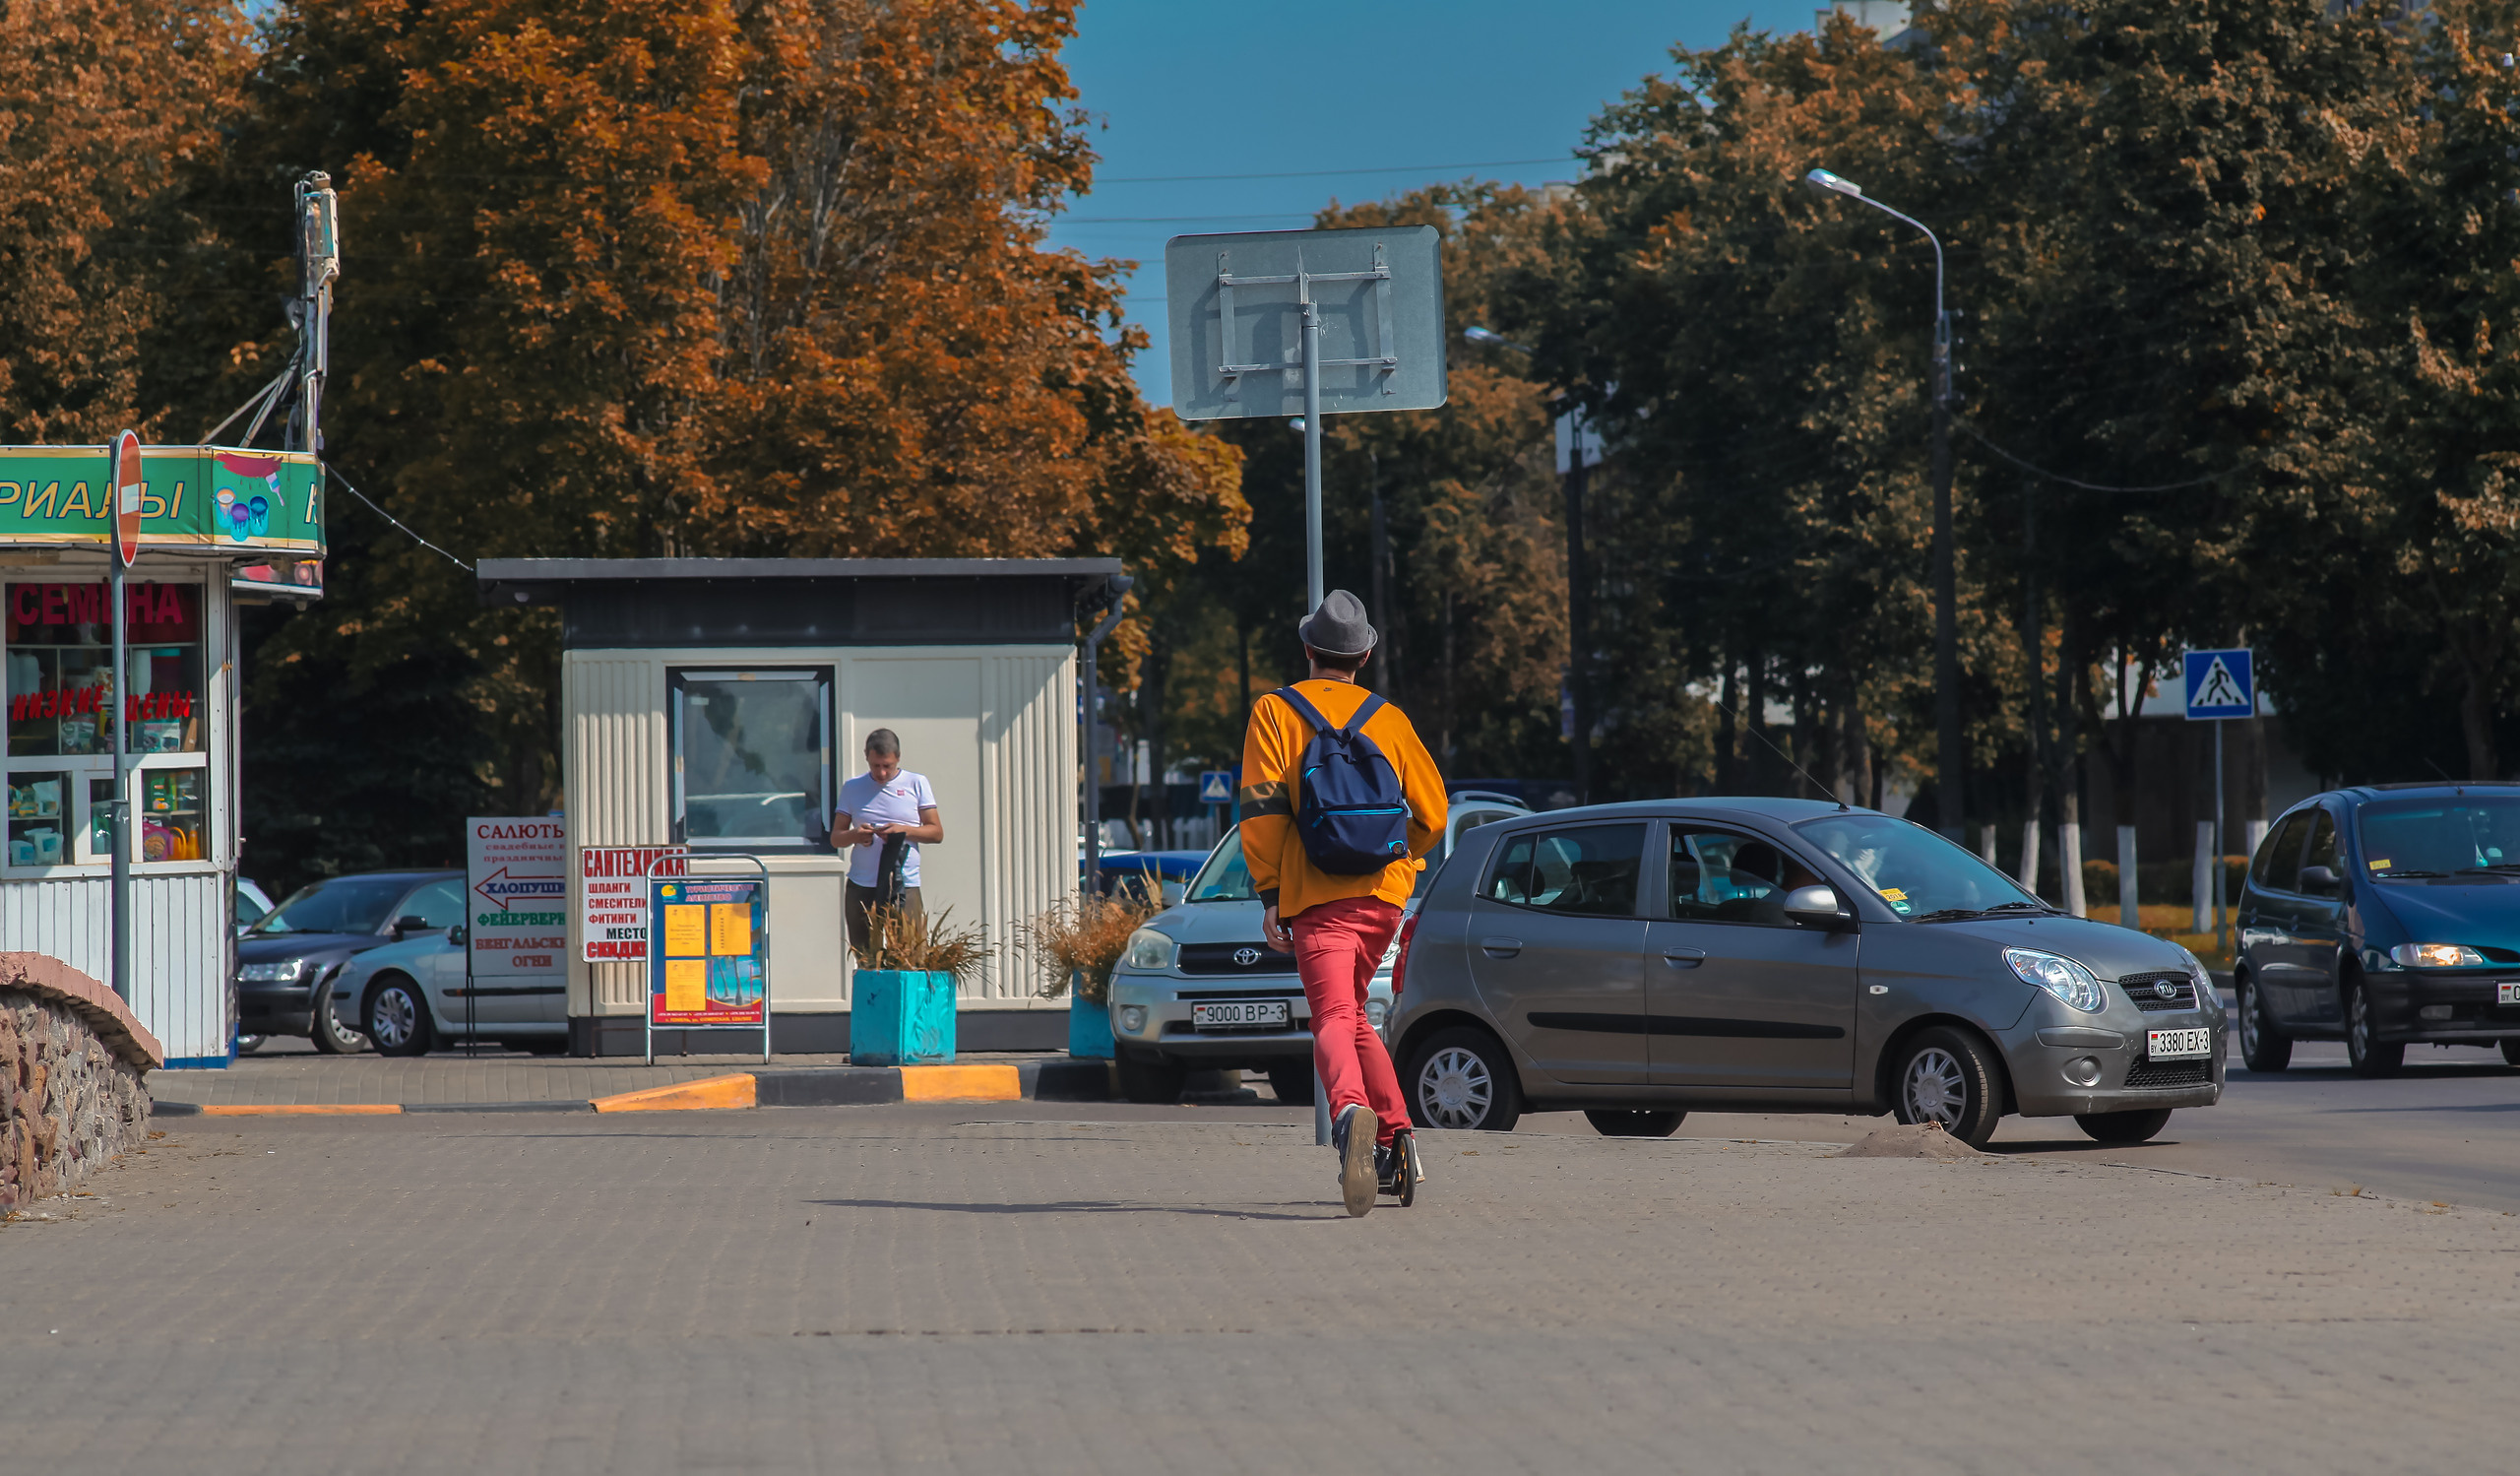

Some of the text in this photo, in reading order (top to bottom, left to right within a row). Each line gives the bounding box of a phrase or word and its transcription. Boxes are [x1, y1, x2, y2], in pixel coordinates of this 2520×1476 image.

[13, 685, 192, 722] НИЗКИЕ ЦЕНЫ
[584, 849, 685, 877] САНТЕХНИКА
[589, 883, 631, 893] ШЛАНГИ
[589, 914, 637, 924] ФИТИНГИ
[512, 955, 552, 968] ОГНИ
[1207, 1005, 1285, 1022] 9000 BP-3
[2160, 1031, 2209, 1053] 3380 EX-3
